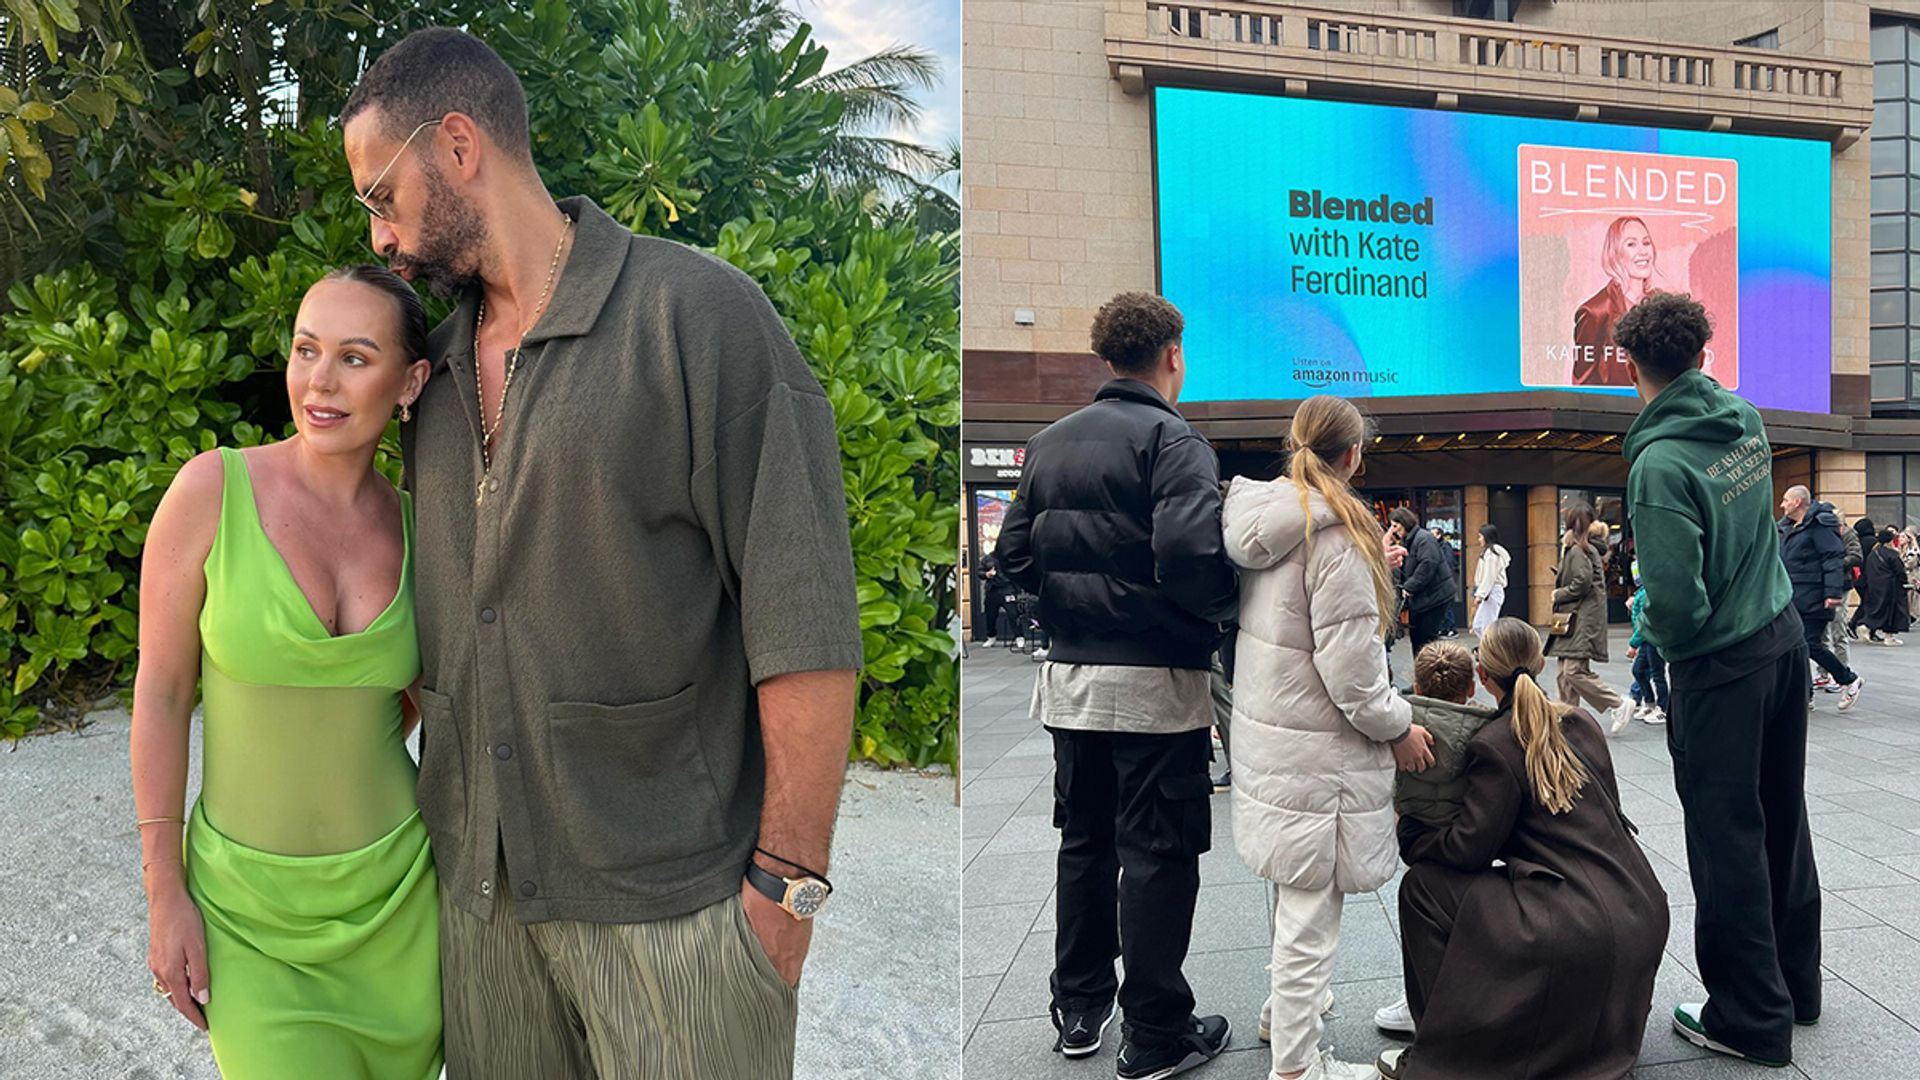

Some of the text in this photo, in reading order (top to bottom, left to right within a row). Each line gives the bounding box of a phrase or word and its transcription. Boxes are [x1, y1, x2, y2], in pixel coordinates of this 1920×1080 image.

[1531, 159, 1726, 205] BLENDED
[1289, 189, 1433, 226] Blended
[1290, 227, 1420, 262] with Kate
[1291, 265, 1428, 299] Ferdinand
[1292, 357, 1332, 367] Listen on
[1546, 345, 1594, 363] KATE
[1292, 367, 1400, 384] amazon music
[1706, 462, 1723, 479] BE
